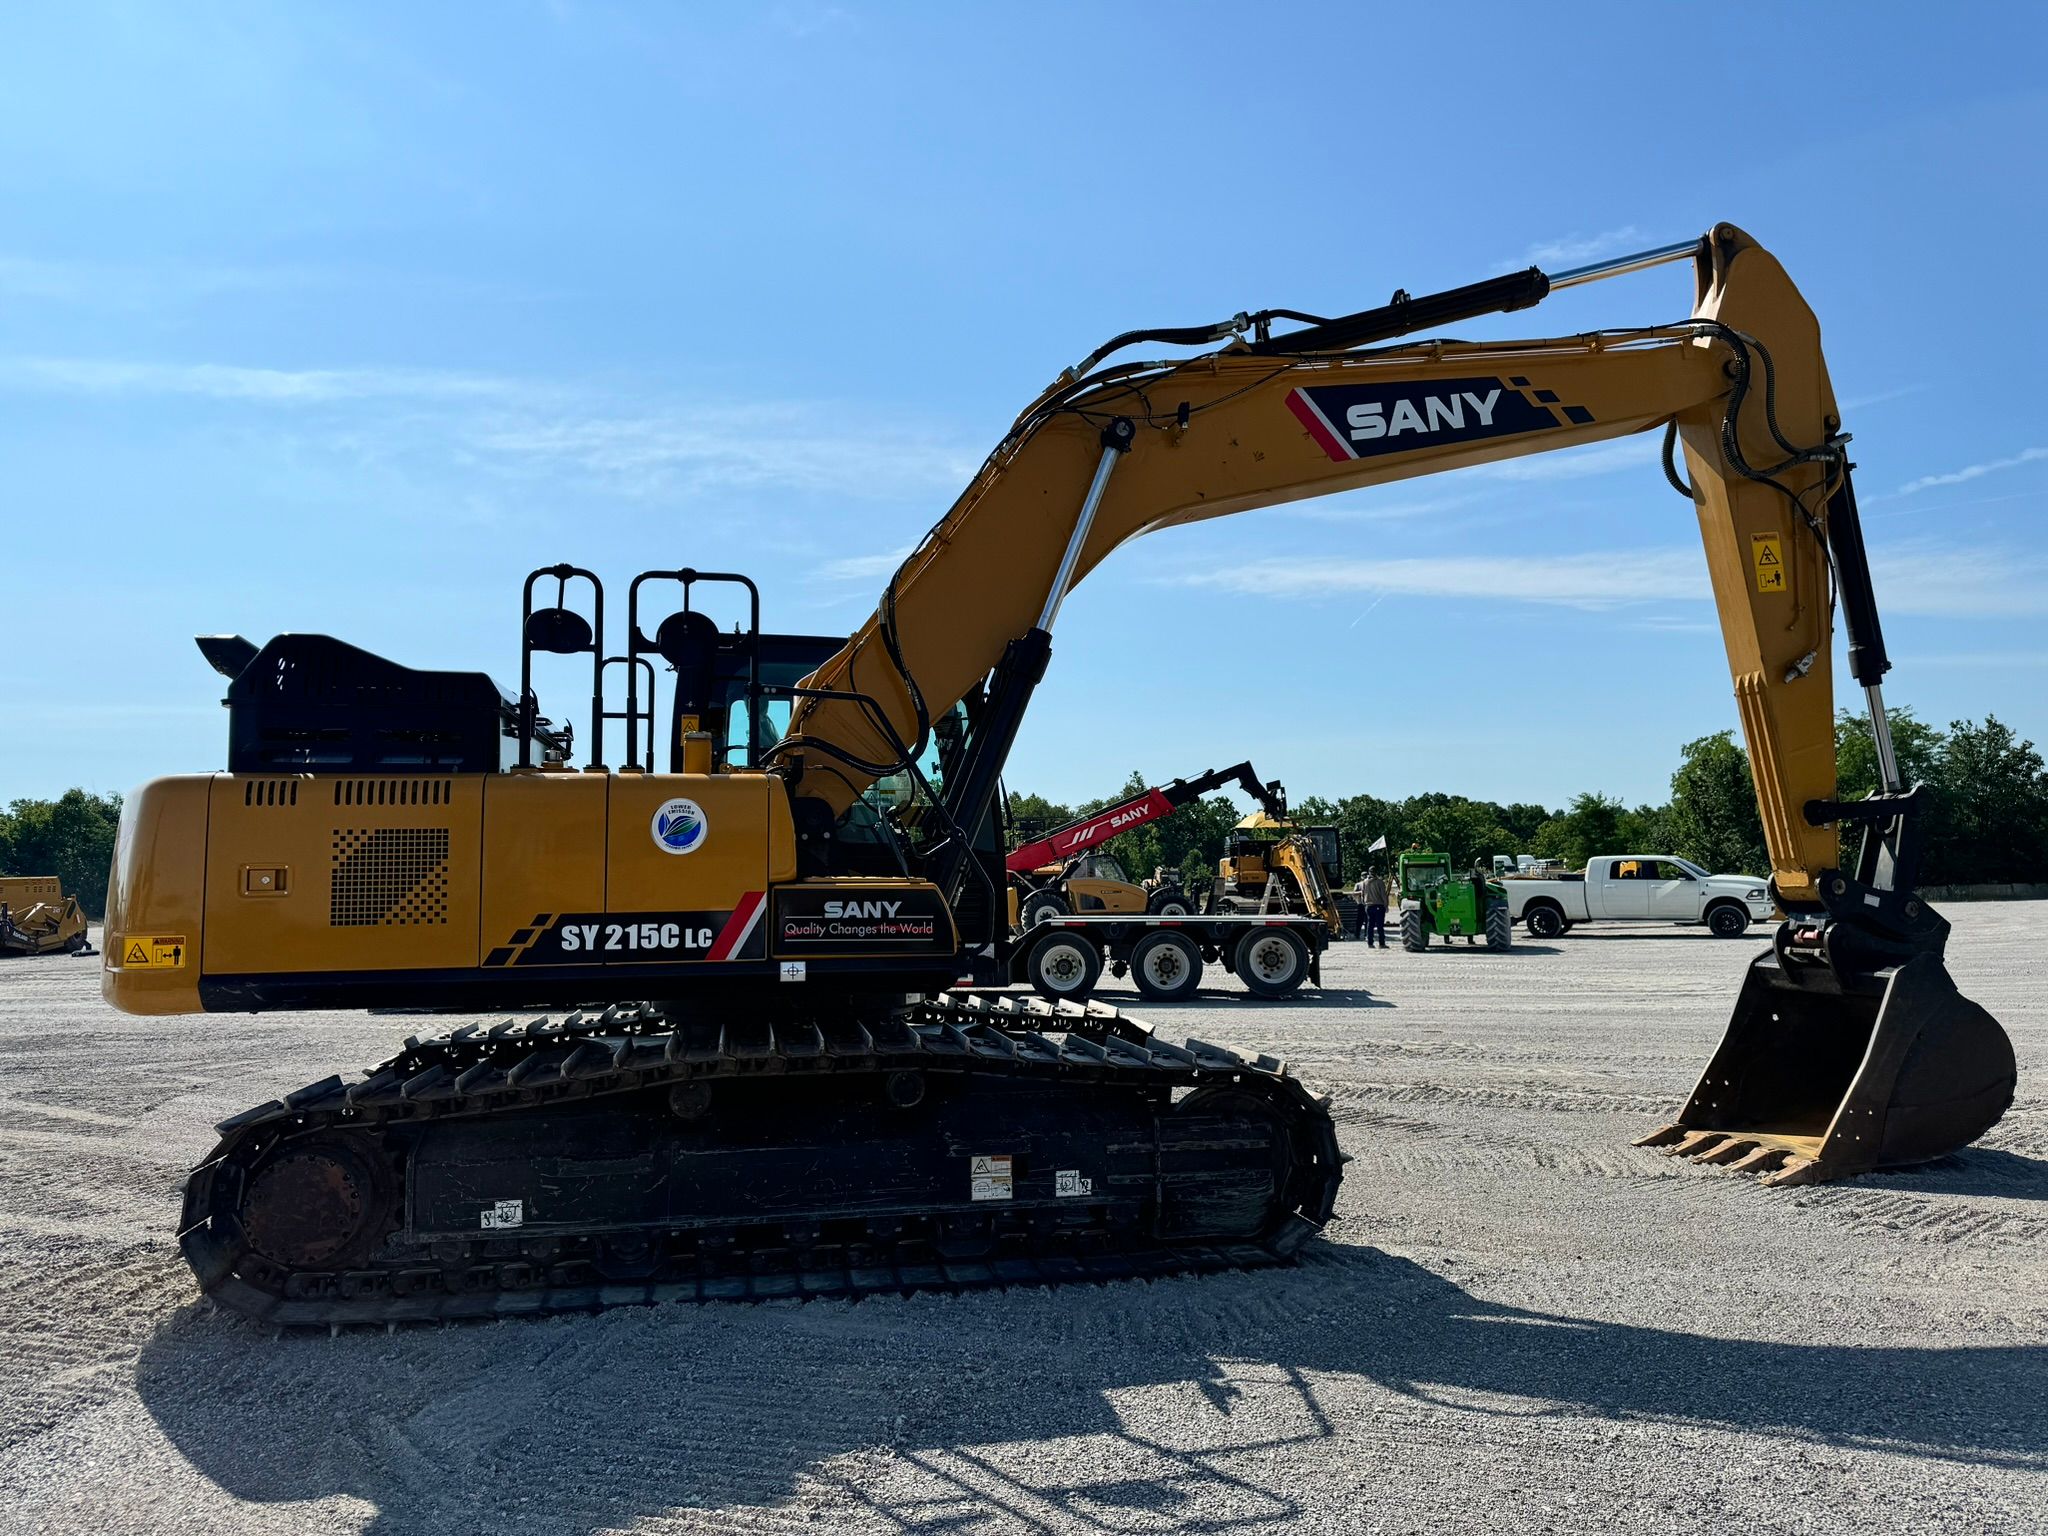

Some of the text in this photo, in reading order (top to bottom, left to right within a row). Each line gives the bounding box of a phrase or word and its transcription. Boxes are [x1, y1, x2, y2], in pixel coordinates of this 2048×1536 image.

[1346, 389, 1501, 441] SANY
[1110, 804, 1149, 828] SANY
[824, 901, 902, 918] SANY
[561, 924, 712, 950] SY 215C LC
[785, 922, 933, 937] Quality Changes the World
